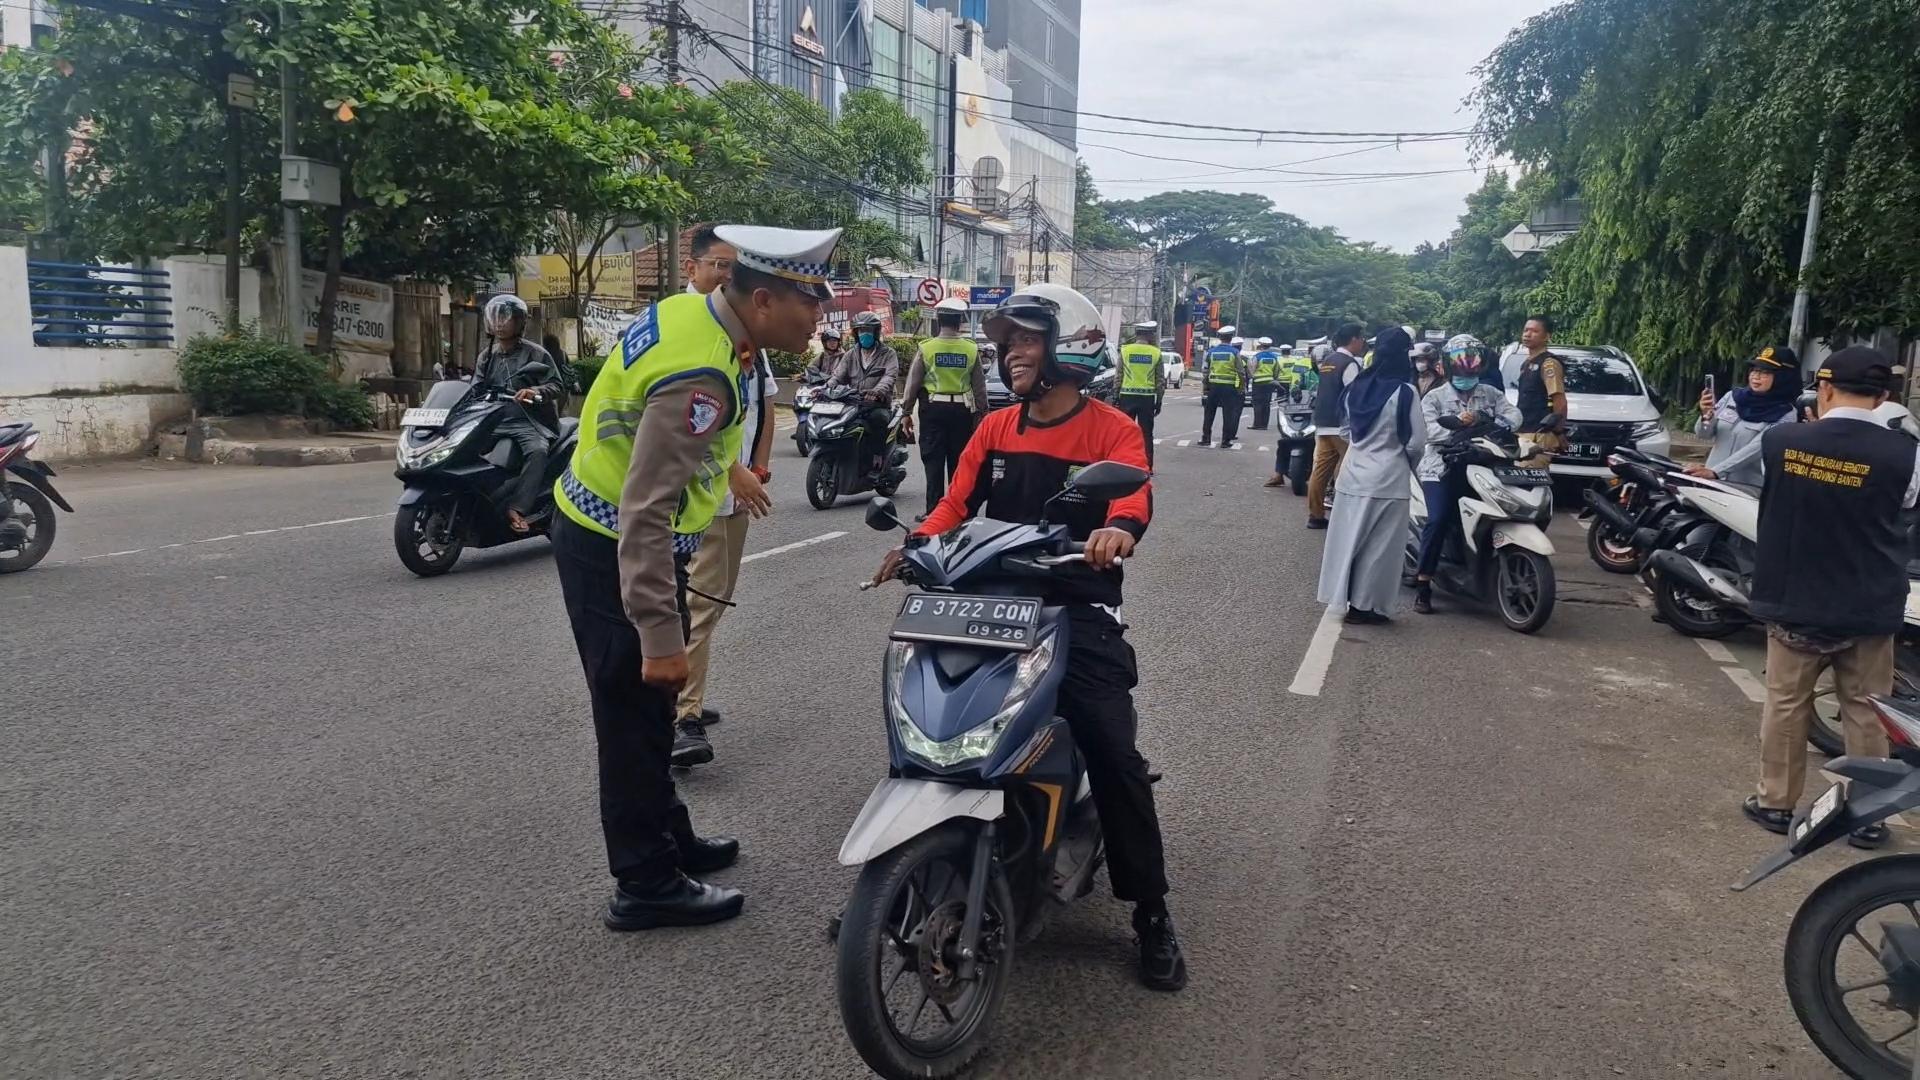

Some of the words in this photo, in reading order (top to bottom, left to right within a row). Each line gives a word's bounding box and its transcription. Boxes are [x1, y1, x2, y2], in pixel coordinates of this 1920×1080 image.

[793, 33, 825, 56] EIGER
[1018, 263, 1058, 272] mndri
[1019, 273, 1049, 283] tape
[936, 355, 966, 365] POLISI
[1565, 444, 1582, 453] 081
[1590, 445, 1600, 454] CN
[1808, 468, 1837, 483] PROVINSI
[1837, 474, 1863, 487] BANTEN
[909, 600, 923, 614] B
[933, 601, 985, 618] 3722
[993, 604, 1032, 624] CON
